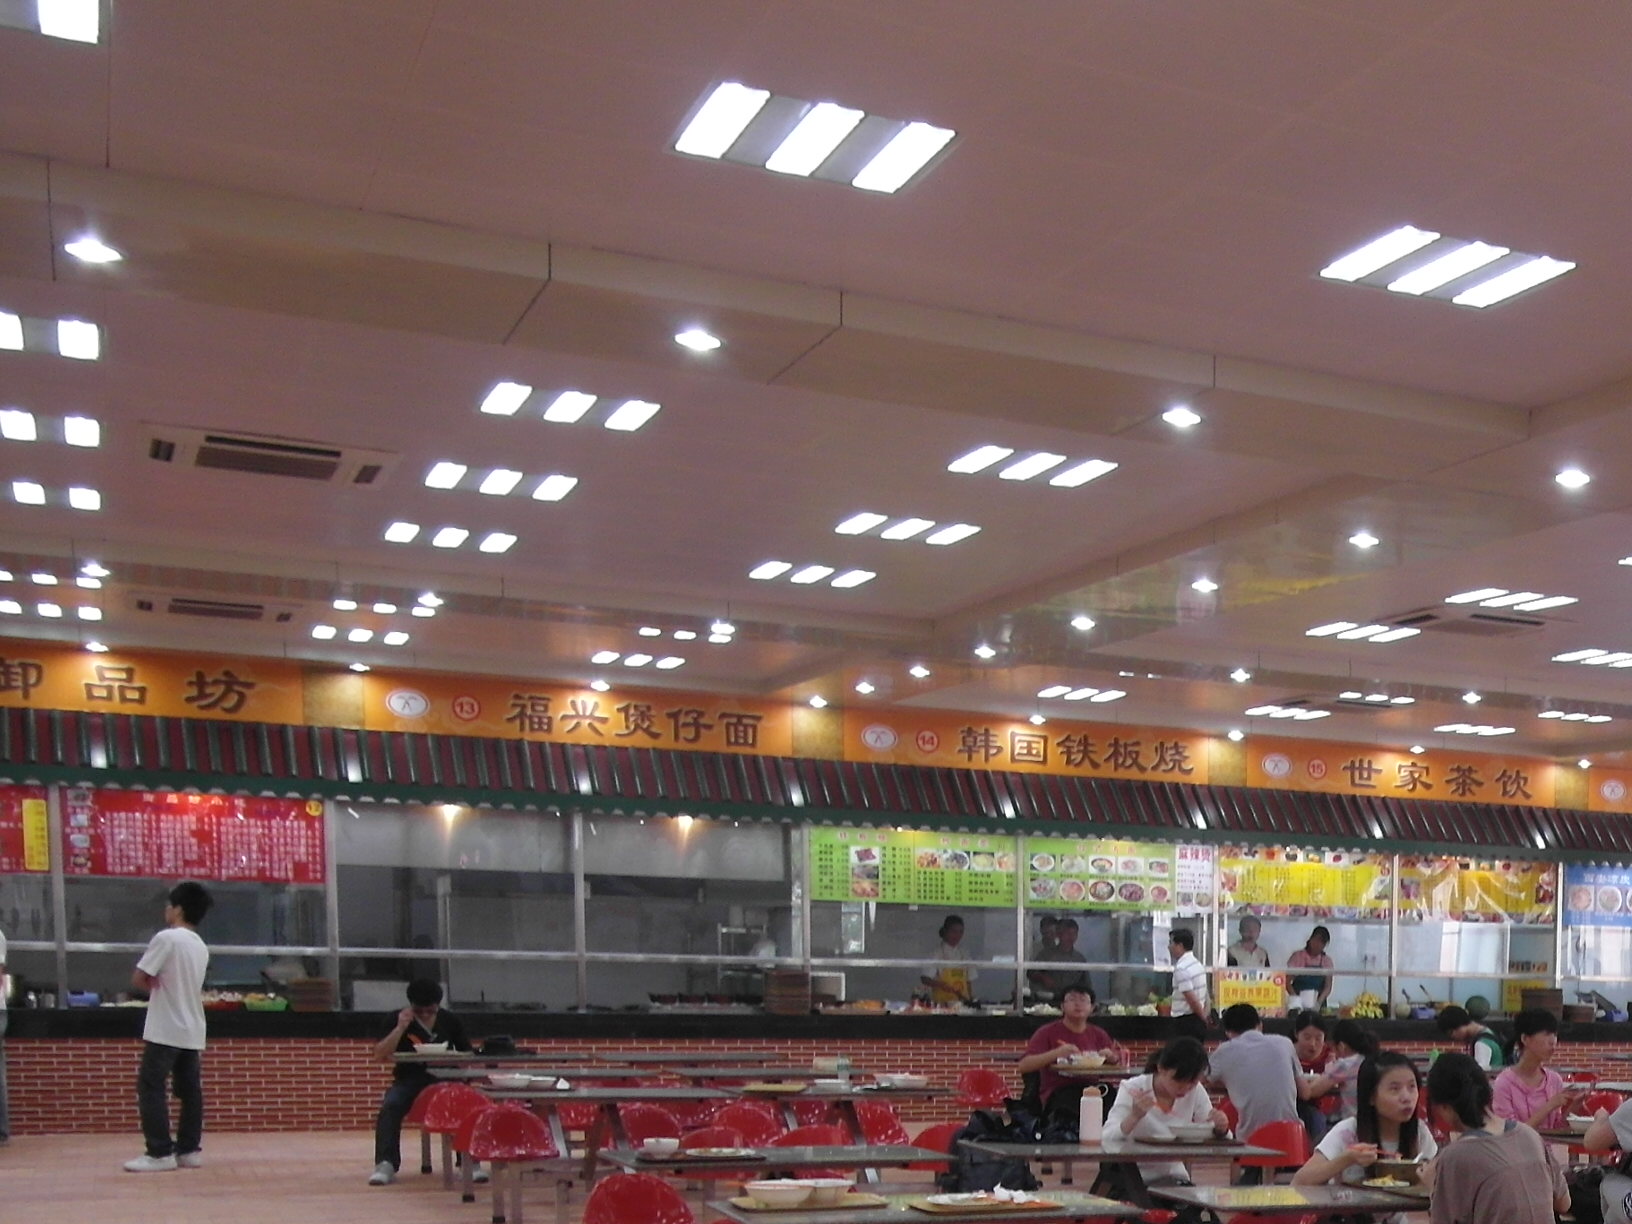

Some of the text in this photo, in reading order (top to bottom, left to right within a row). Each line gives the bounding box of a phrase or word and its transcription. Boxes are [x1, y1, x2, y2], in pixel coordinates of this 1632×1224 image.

[504, 692, 764, 749] 福兴煲仔面
[955, 726, 1195, 776] 韩国铁板烧
[1341, 757, 1534, 800] 世家茶饮
